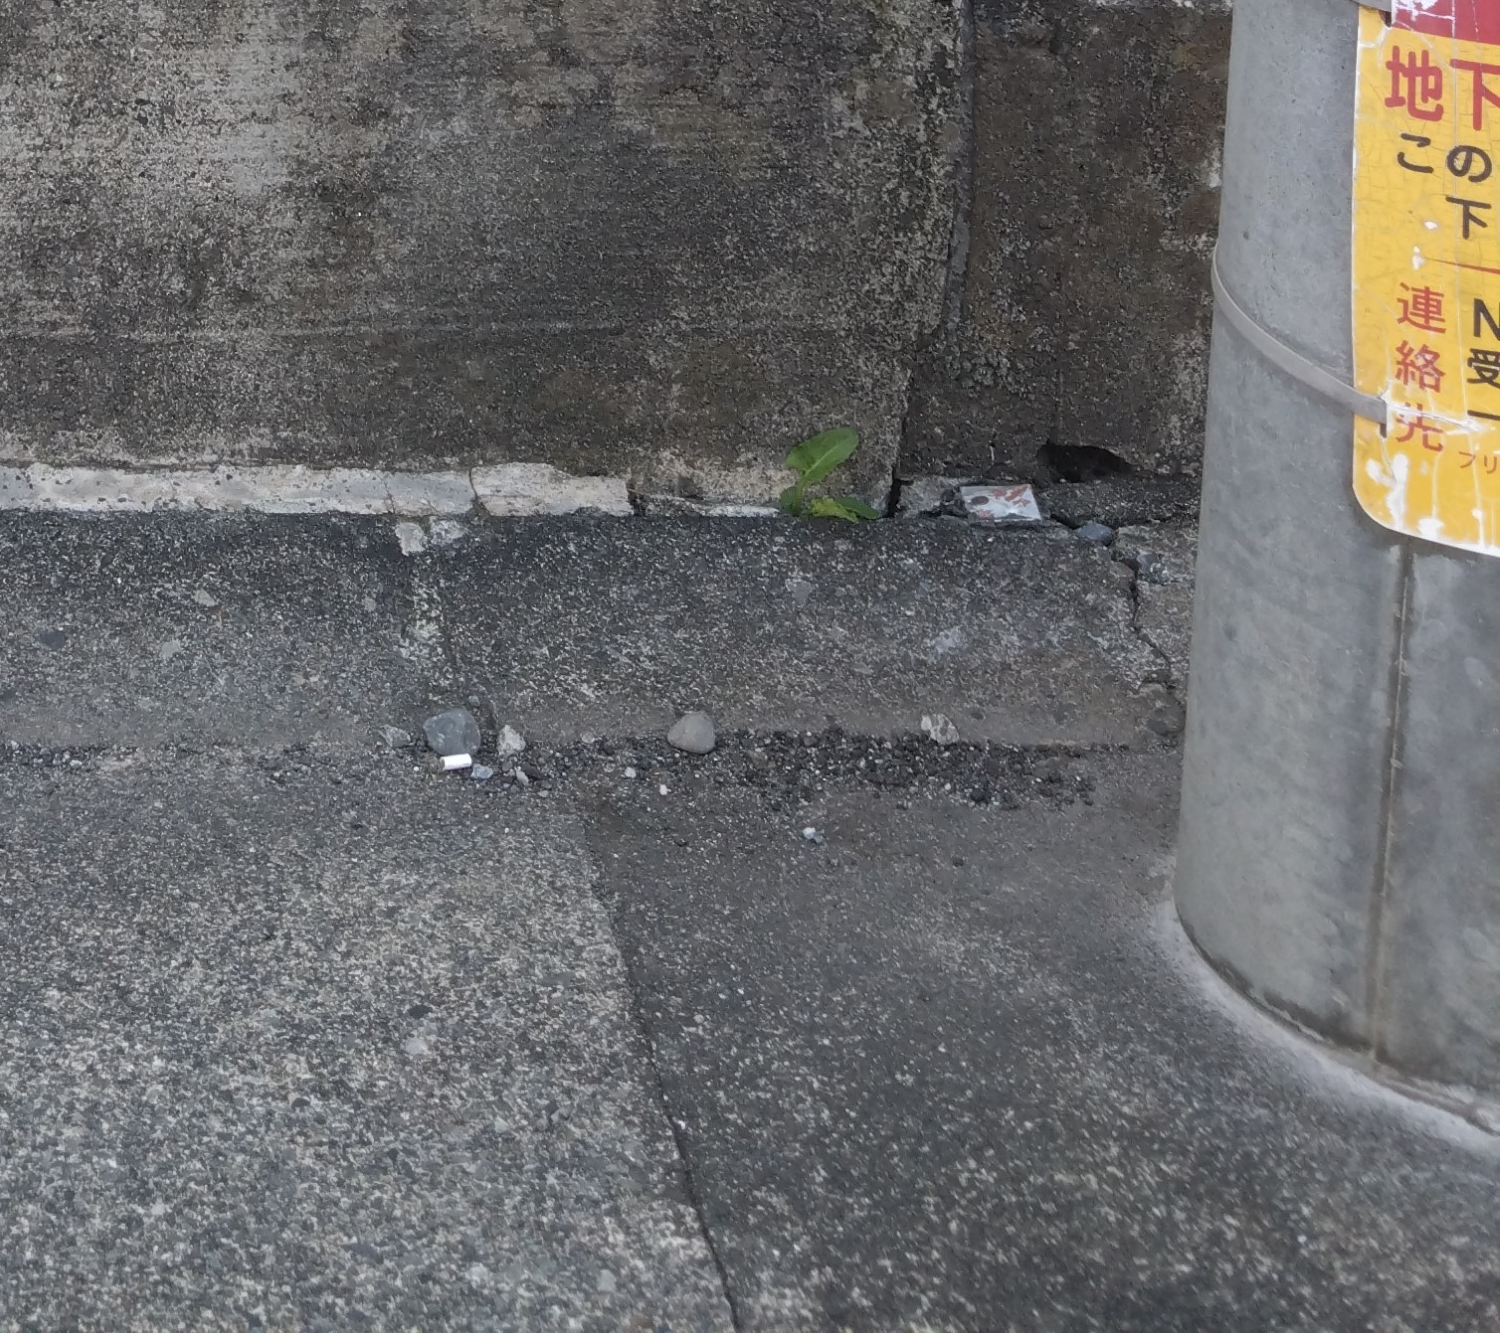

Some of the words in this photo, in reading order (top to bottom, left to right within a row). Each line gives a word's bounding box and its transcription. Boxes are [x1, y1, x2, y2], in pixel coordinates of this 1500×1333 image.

[1384, 45, 1500, 131] 地下
[1397, 132, 1493, 183] この
[1445, 196, 1492, 240] 下
[1394, 282, 1446, 452] 連絡先
